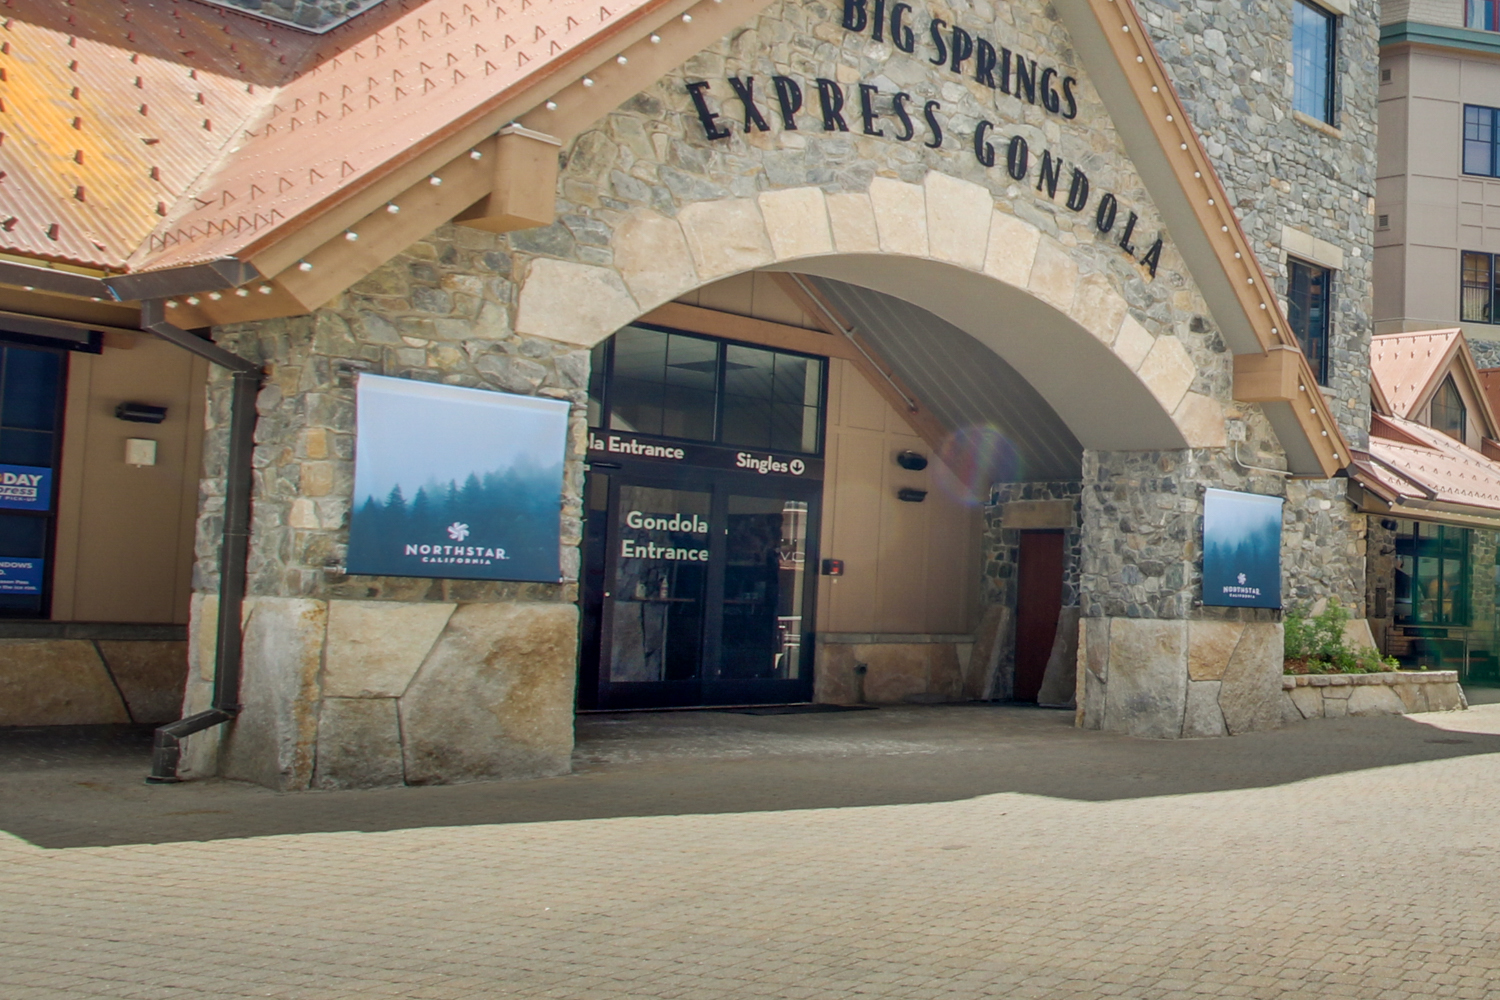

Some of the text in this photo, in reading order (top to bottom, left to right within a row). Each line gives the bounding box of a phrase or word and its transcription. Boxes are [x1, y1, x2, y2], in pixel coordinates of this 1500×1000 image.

[928, 17, 1078, 120] SPRINGS
[685, 76, 1164, 279] EXPRESS GONDOLA
[608, 435, 685, 460] Entrance
[736, 452, 789, 475] Singles
[3, 472, 44, 487] DAY
[626, 510, 709, 534] Gondola
[404, 543, 507, 560] NORTHSTAR
[421, 556, 492, 565] CALIFORNIA
[621, 539, 710, 562] Entrance
[1222, 585, 1261, 596] NORTHSTAR
